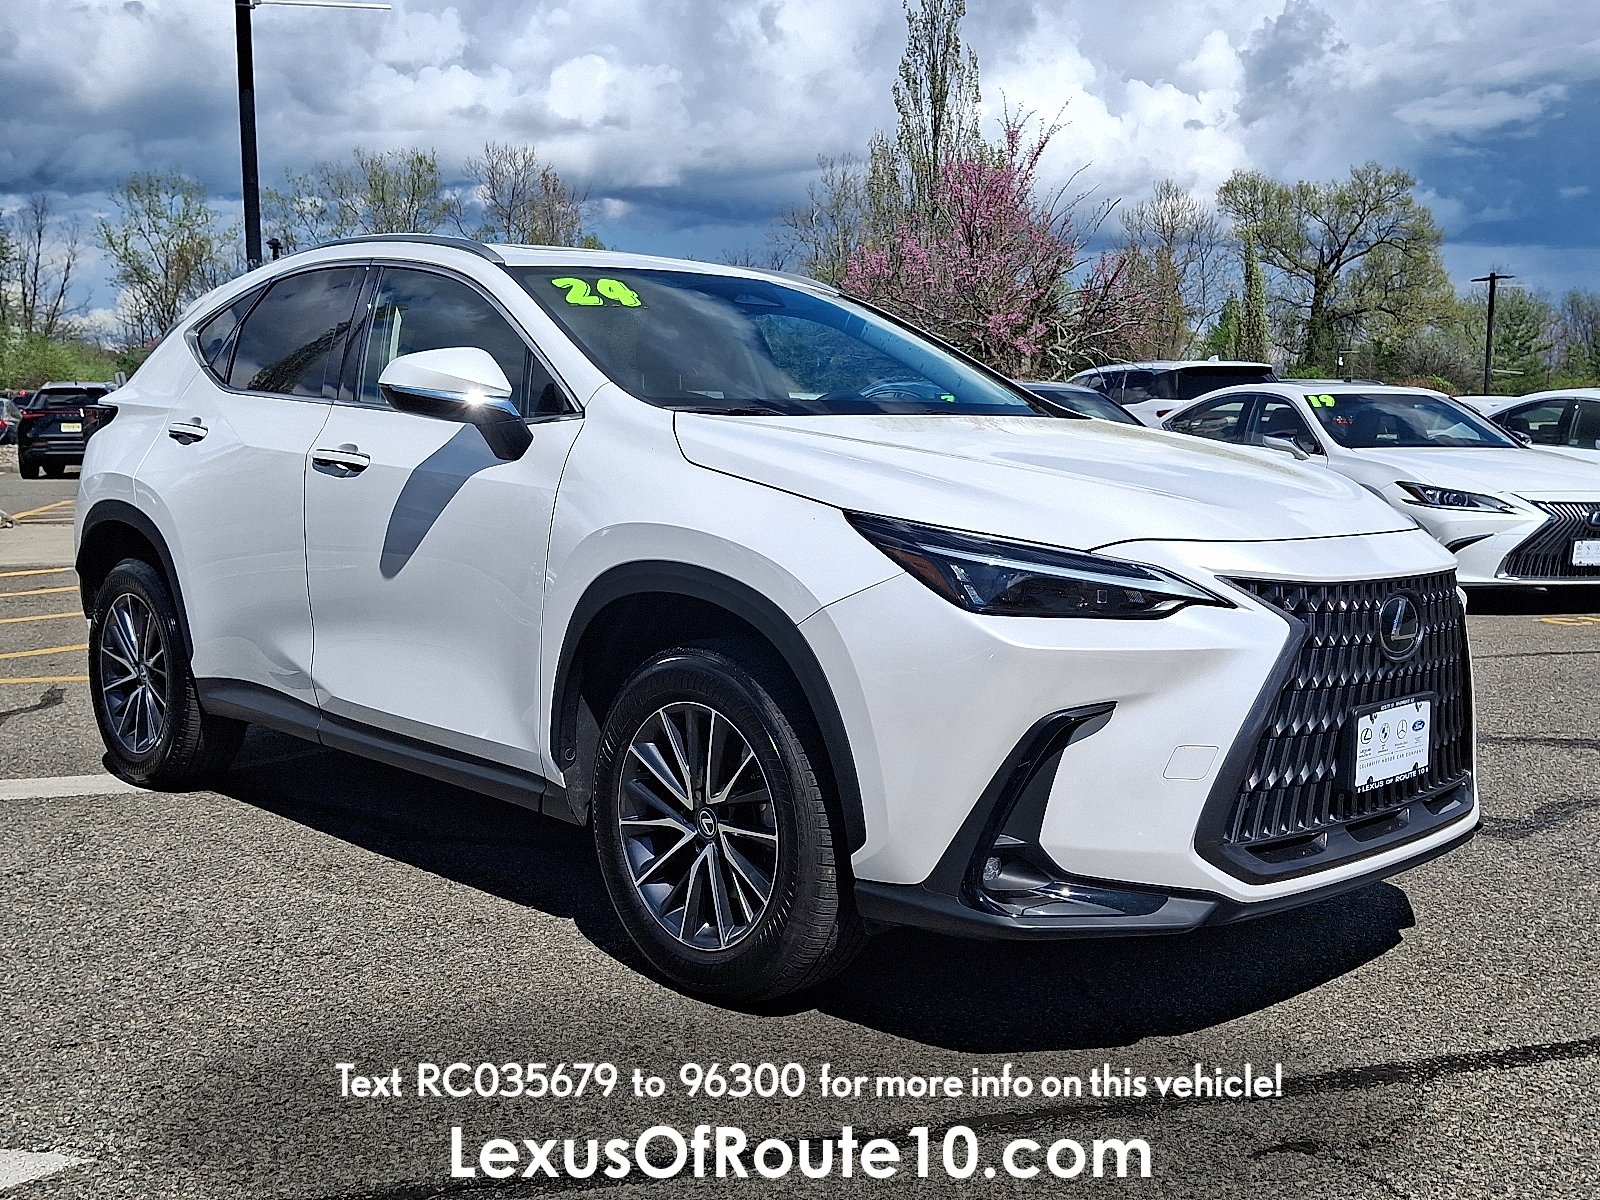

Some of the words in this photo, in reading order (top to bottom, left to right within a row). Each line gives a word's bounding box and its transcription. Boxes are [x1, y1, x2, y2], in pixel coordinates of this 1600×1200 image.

[1307, 394, 1336, 408] 19
[1362, 781, 1384, 792] LEXUS
[1395, 771, 1416, 782] ROUTE
